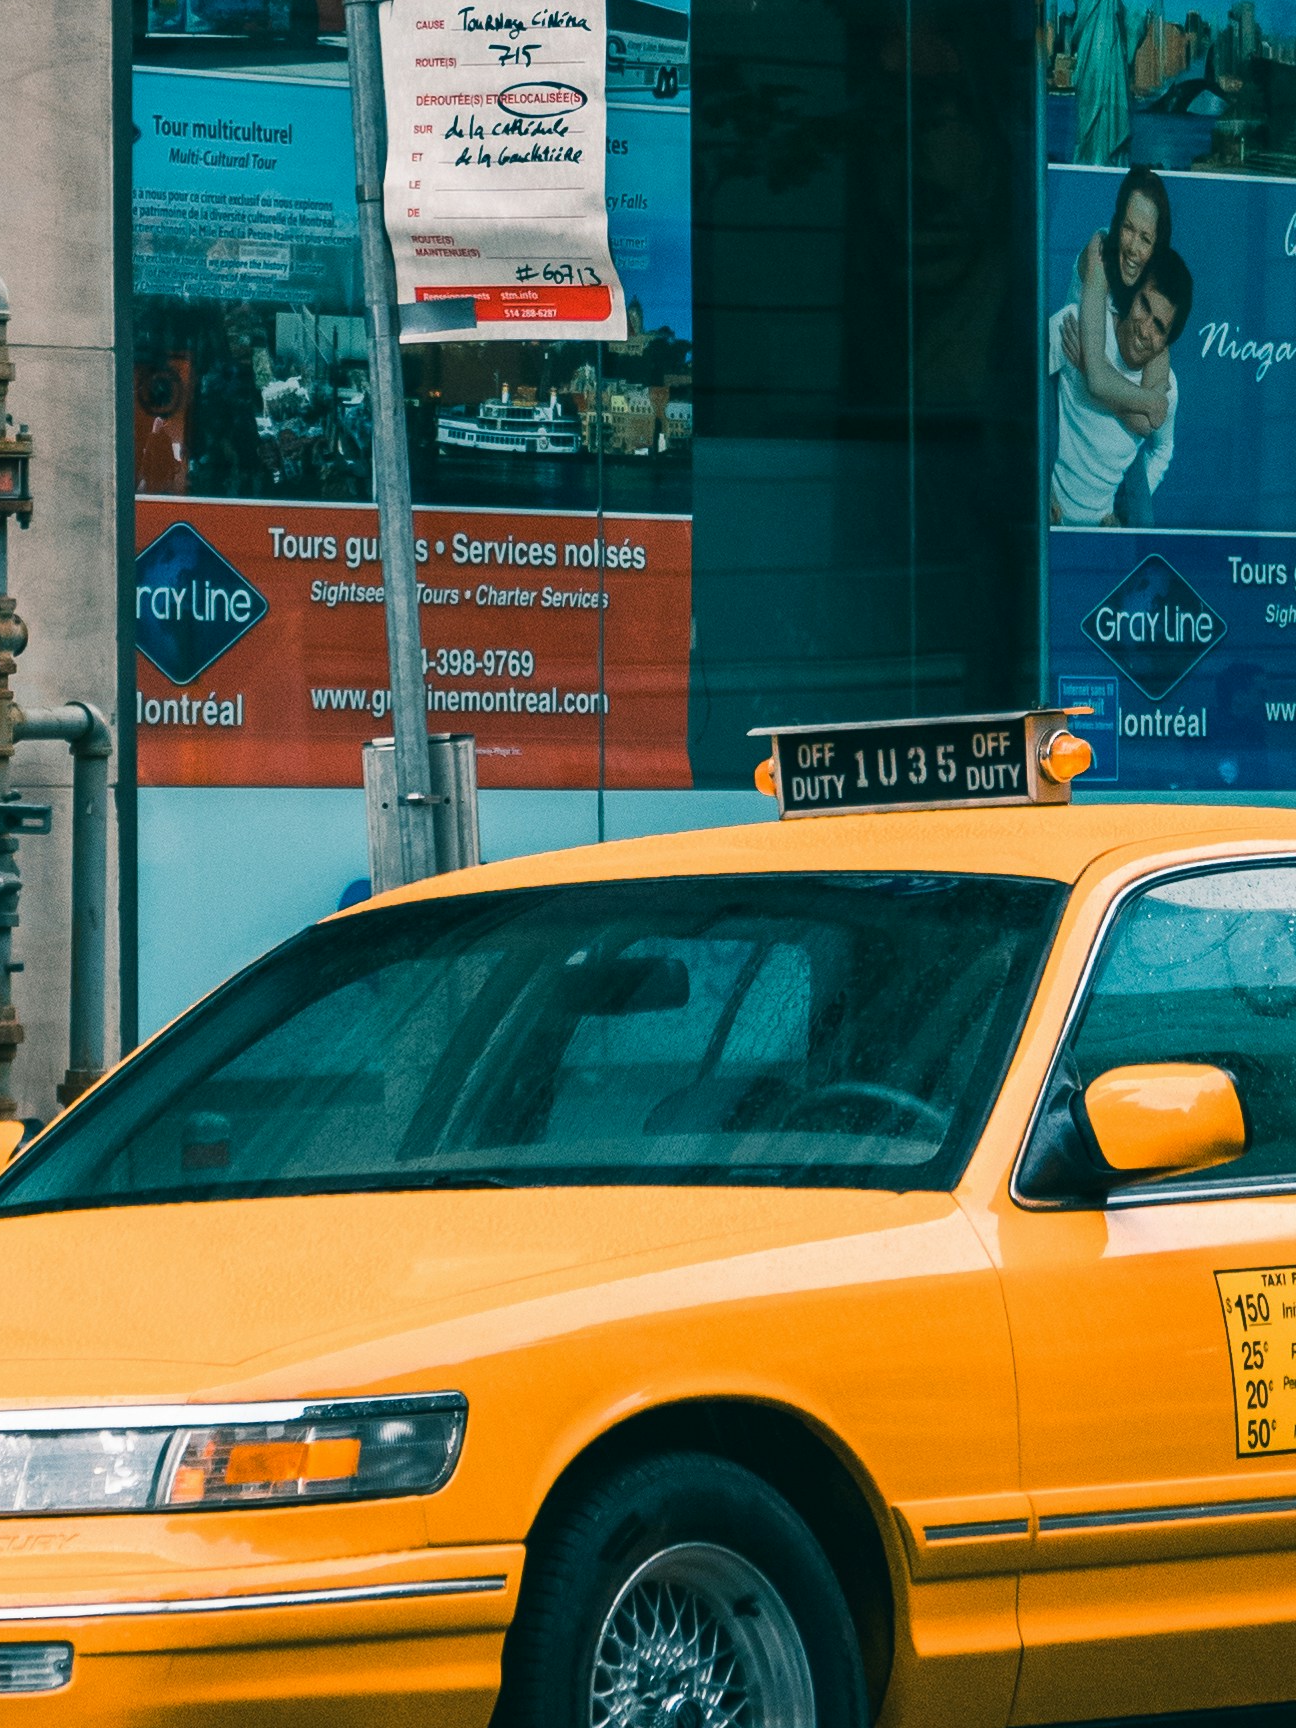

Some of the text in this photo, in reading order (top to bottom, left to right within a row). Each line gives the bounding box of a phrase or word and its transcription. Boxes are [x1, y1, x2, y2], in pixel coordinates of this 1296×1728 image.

[415, 19, 445, 30] CAUSE
[415, 57, 457, 68] ROUTE(S)
[488, 43, 543, 68] 715
[416, 87, 582, 107] DÉROUTÉE(S) ET RELOCALISÉE(S
[152, 114, 293, 145] Tour multiculturel
[413, 124, 433, 135] SUR
[168, 147, 278, 171] Multi-Cultural Tour
[411, 152, 423, 162] ET
[409, 180, 421, 190] LE
[407, 208, 420, 218] DE
[620, 194, 648, 210] Falls
[410, 234, 455, 246] ROUTE(S)
[415, 248, 481, 259] MAINTENUE(S)
[500, 290, 538, 301] stm.info
[267, 526, 337, 560] Tours
[452, 532, 556, 567] Services
[1228, 556, 1288, 585] Tours
[310, 579, 609, 609] Sightsee Tours Charter Services
[135, 690, 244, 726] ontréal
[1118, 706, 1207, 737] ontréal
[797, 743, 835, 769] OFF
[971, 732, 1011, 758] OFF
[854, 744, 958, 788] 1U35
[965, 763, 1021, 791] DUTY
[792, 774, 846, 801] DUTY
[1261, 1273, 1287, 1287] TAXI
